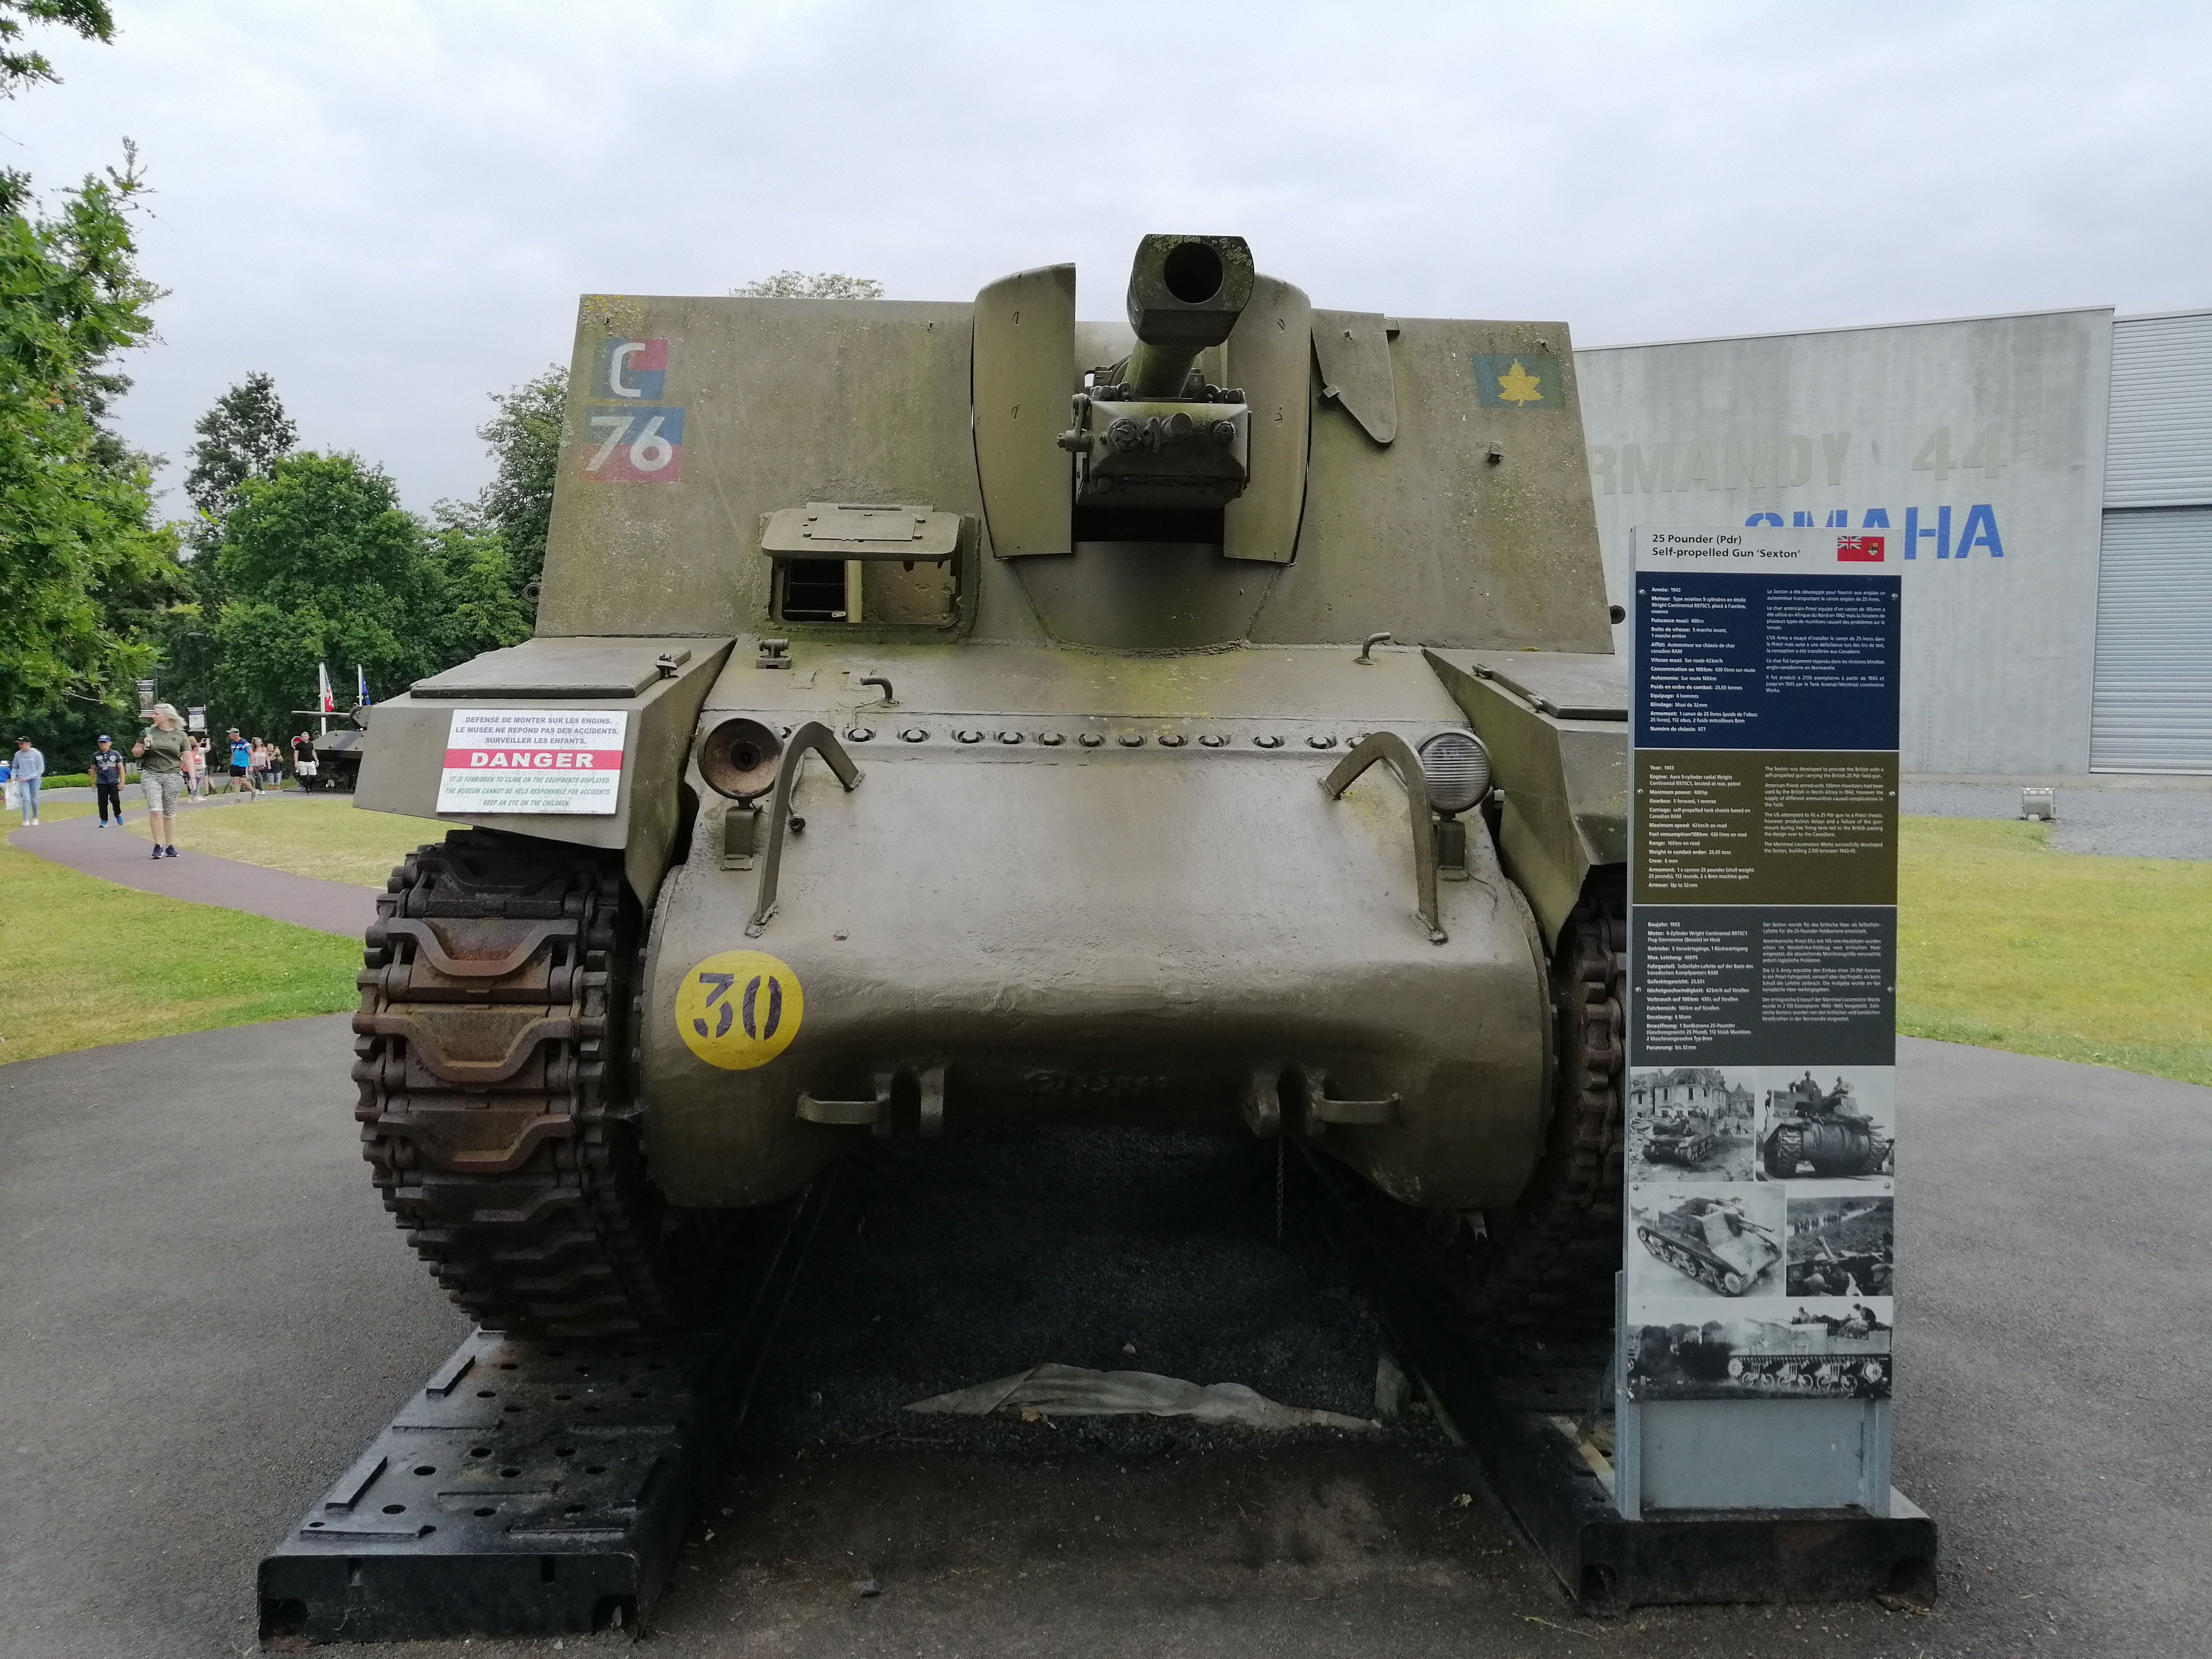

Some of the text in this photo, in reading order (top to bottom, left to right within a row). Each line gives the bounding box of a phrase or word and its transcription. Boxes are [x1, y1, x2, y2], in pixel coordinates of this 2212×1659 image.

[610, 343, 645, 397] C
[585, 416, 673, 471] 76
[1912, 423, 2008, 480] 44
[1653, 547, 1728, 558] Self-propelled
[1669, 535, 1713, 543] Pounder
[1717, 535, 1741, 545] (Pdr)
[470, 753, 593, 767] DANGER
[693, 972, 782, 1040] 30
